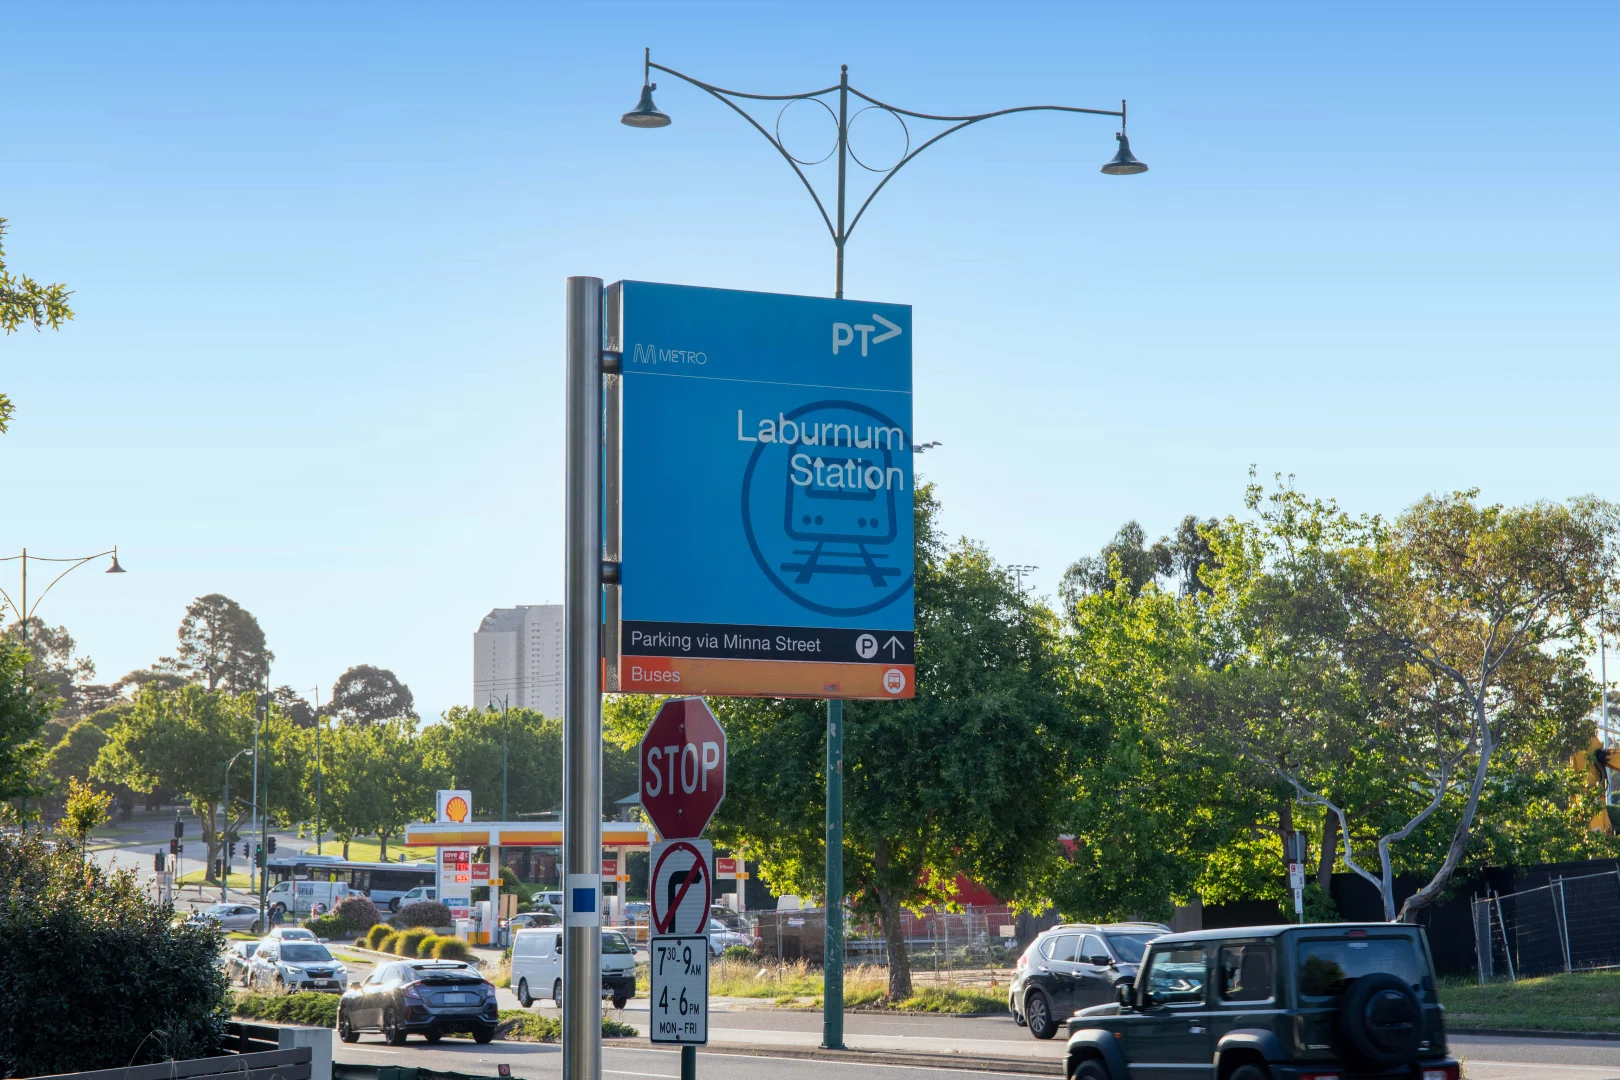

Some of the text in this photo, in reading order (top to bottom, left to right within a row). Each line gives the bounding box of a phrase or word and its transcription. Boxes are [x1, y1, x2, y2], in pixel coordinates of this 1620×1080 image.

[659, 348, 707, 365] METRO
[737, 409, 904, 451] Laburnum
[790, 453, 904, 491] Station
[631, 630, 692, 652] Parking
[697, 634, 719, 650] via
[724, 634, 771, 651] Minna
[775, 635, 822, 652] Street
[631, 666, 681, 683] Buses
[645, 741, 720, 798] STOP
